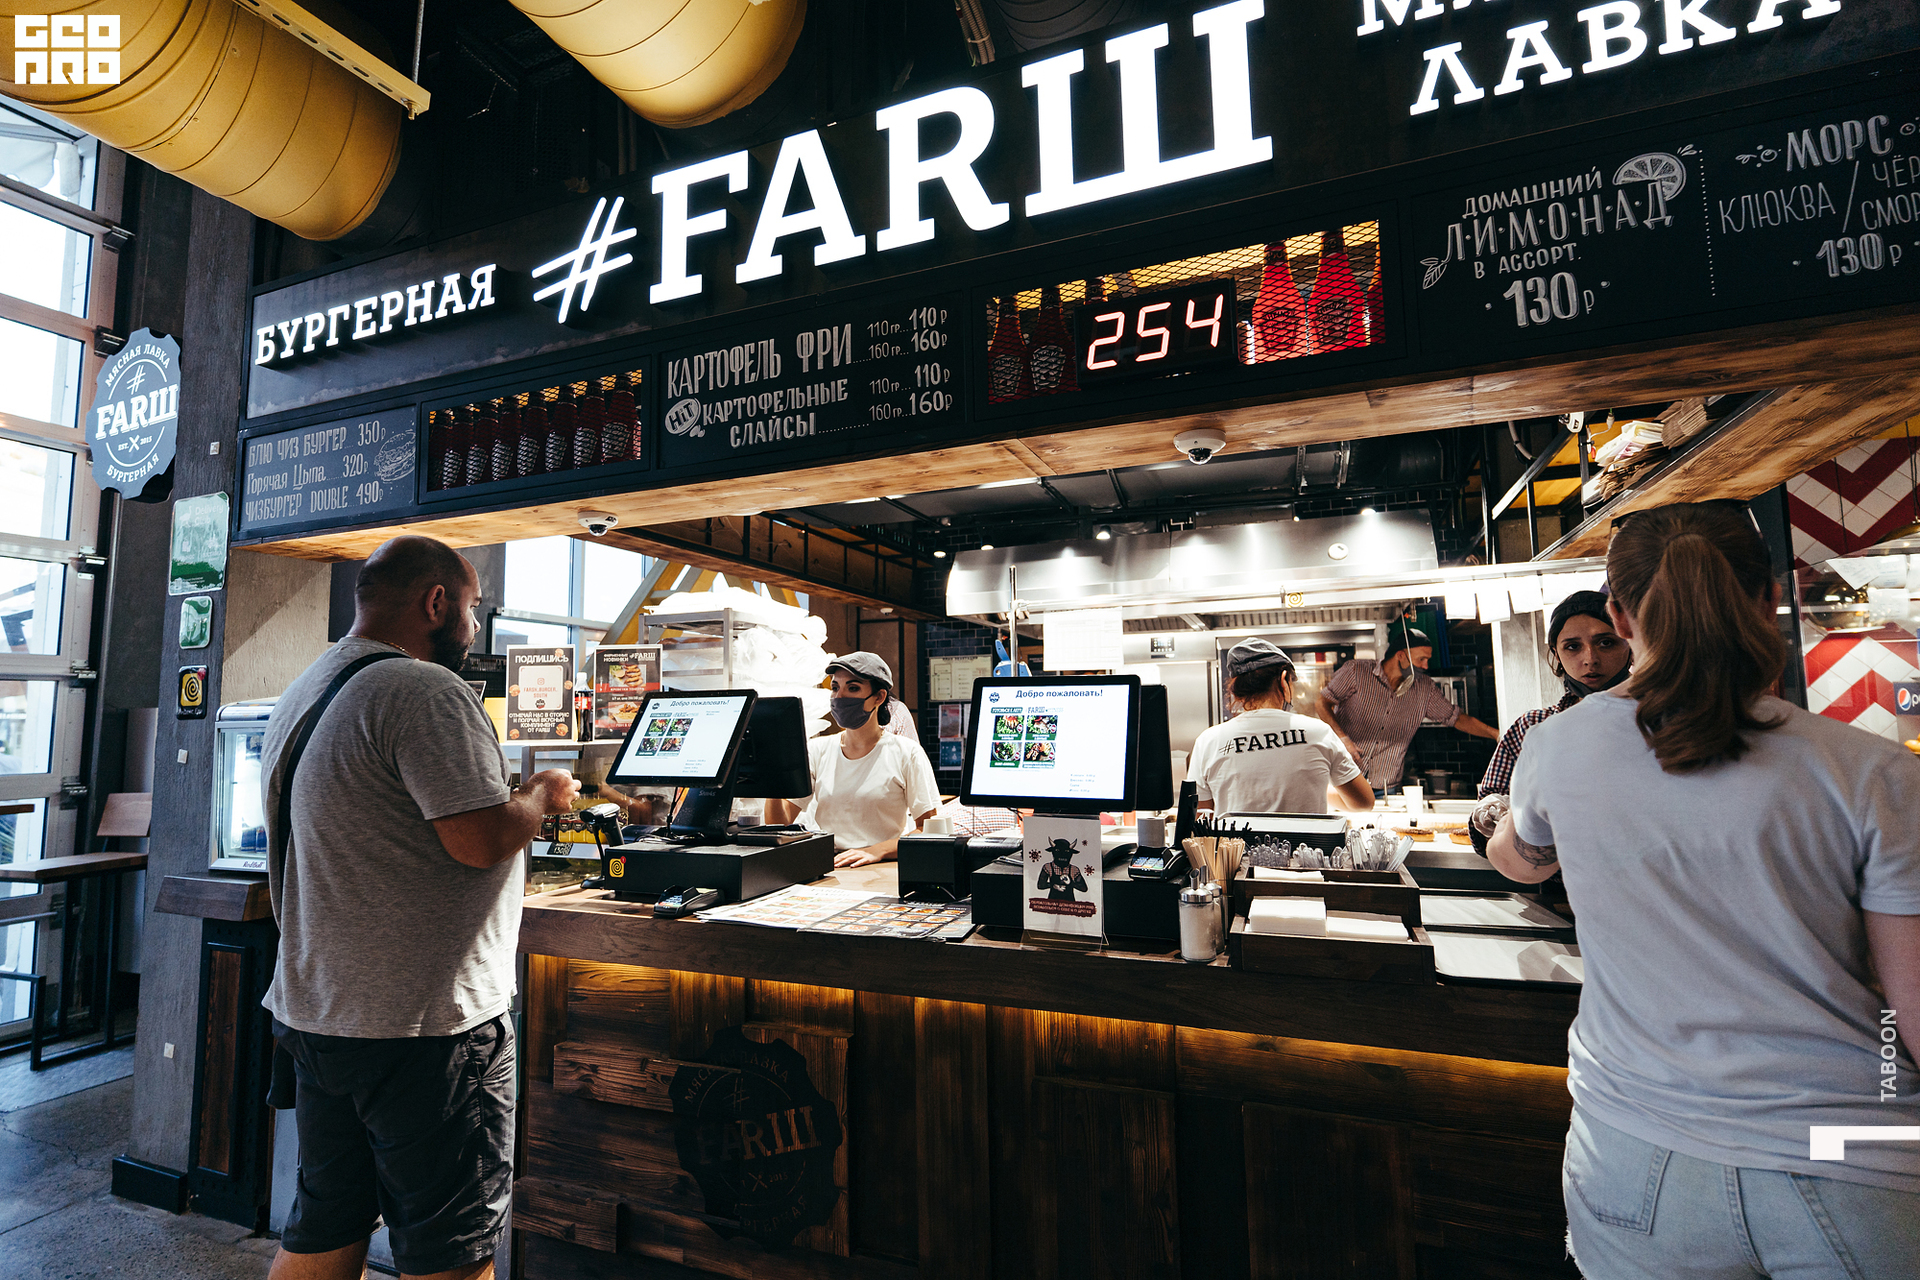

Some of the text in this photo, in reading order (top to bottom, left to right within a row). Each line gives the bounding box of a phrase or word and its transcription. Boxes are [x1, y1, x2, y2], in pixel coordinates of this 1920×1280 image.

[1786, 114, 1893, 172] МОРС
[1462, 166, 1602, 219] ДОМАШНИЙ
[1719, 182, 1836, 234] КЛЮКВА
[1474, 261, 1486, 280] В
[254, 263, 497, 366] БУРГЕРНАЯ
[1086, 294, 1224, 371] 254
[105, 343, 170, 387] МЯСНАЯ ЛАВКА
[667, 323, 852, 399] КАРТОФЕЛЬ ФРИ
[703, 378, 848, 426] КАРТОФЕЛЬНЫЕ
[249, 442, 273, 467] БЛЮ
[277, 437, 299, 460] ЧИЗ
[303, 426, 347, 456] БУРГЕР
[730, 412, 816, 448] СЛАЙСЫ
[106, 452, 160, 483] БУРГЕРНАЯ
[246, 472, 288, 496] Горячая
[245, 493, 302, 522] ЧИЗБУРГЕР
[310, 485, 348, 513] DOUBLE
[1015, 689, 1103, 699] Добро пожаловать!
